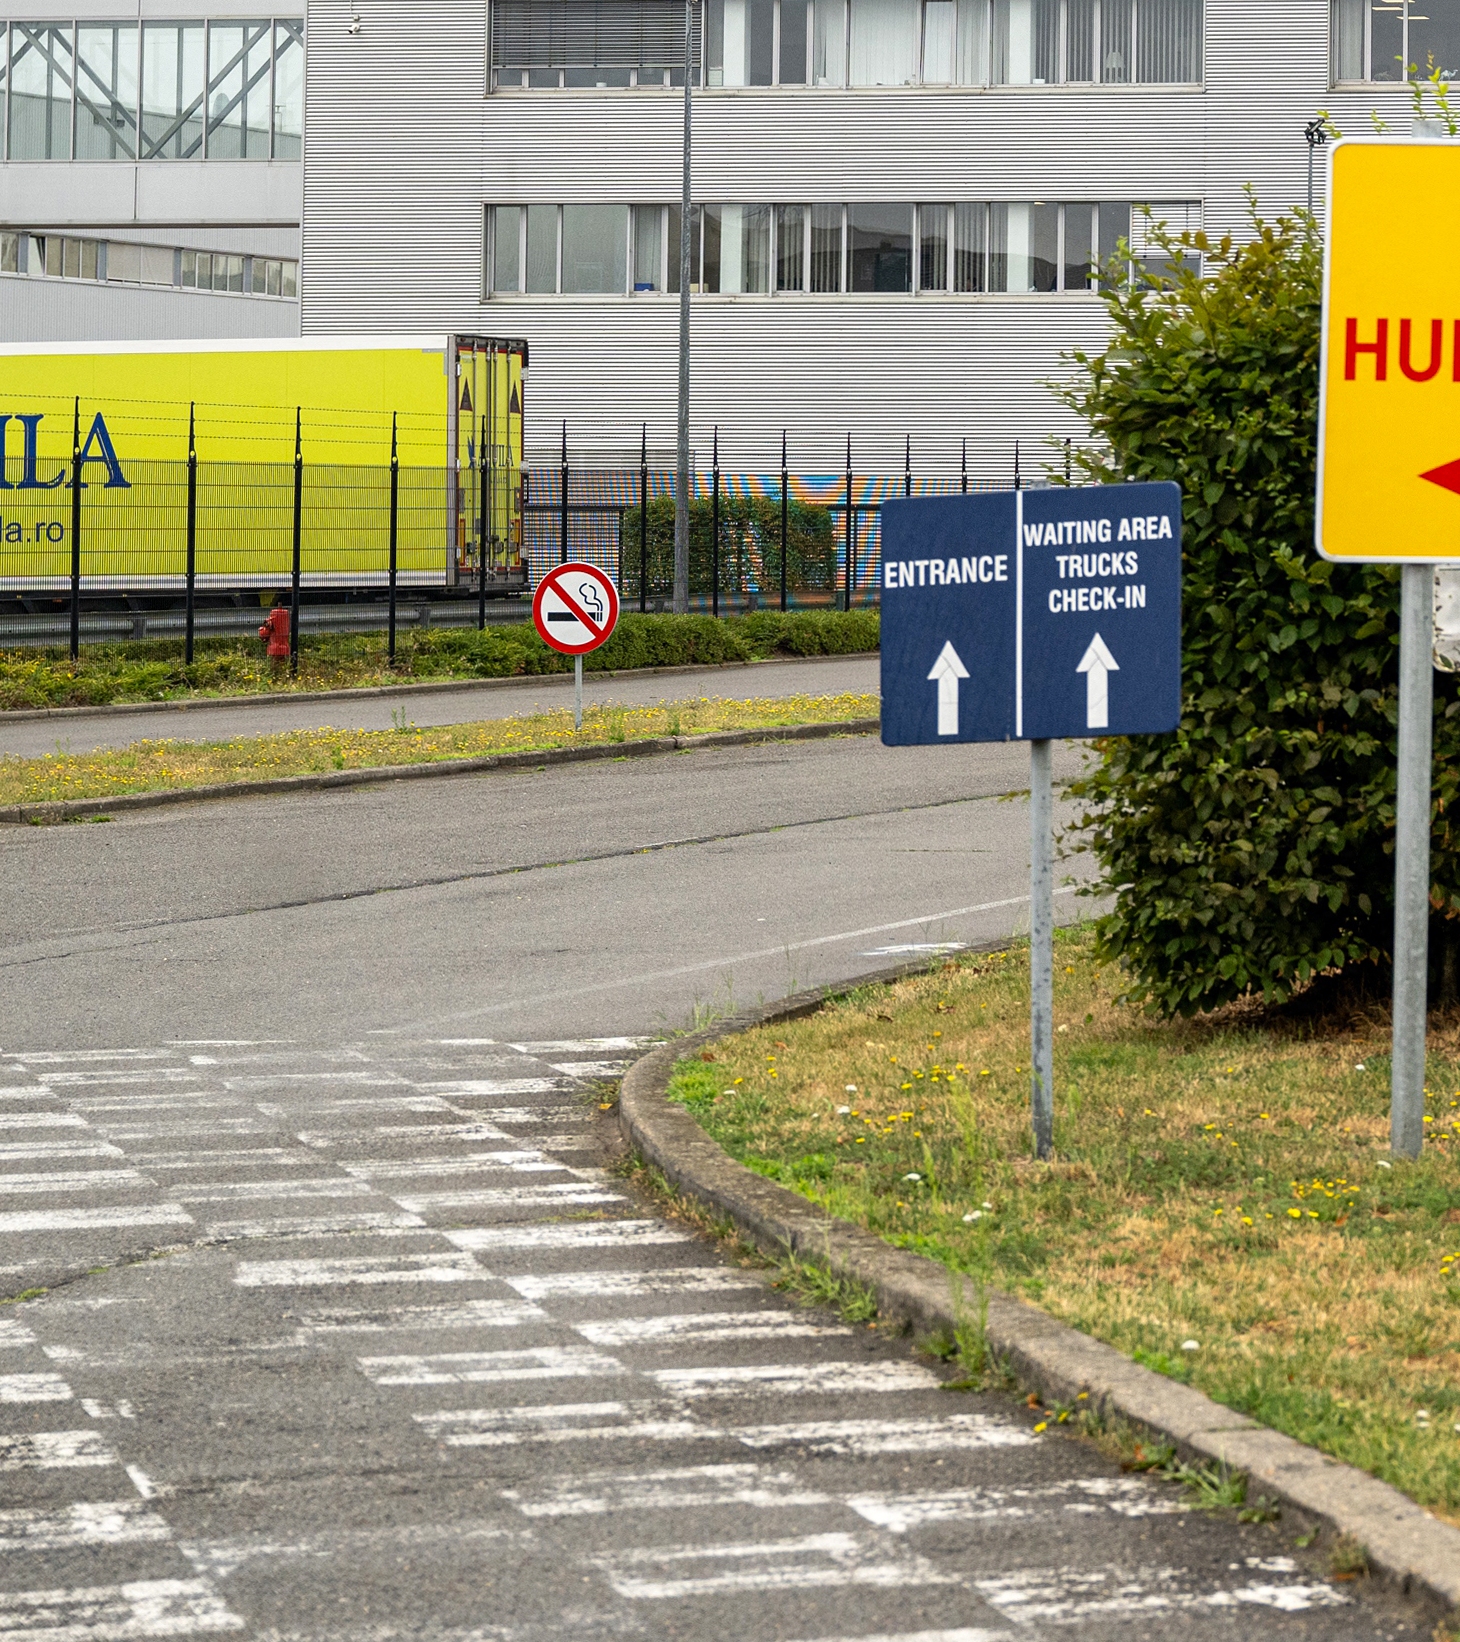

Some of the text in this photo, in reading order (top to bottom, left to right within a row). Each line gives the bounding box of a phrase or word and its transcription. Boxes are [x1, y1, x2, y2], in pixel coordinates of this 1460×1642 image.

[1023, 516, 1173, 548] WAITING AREA
[885, 555, 1009, 589] ENTRANCE
[1056, 551, 1140, 579] TRUCKS
[1048, 585, 1147, 614] CHECK-IN
